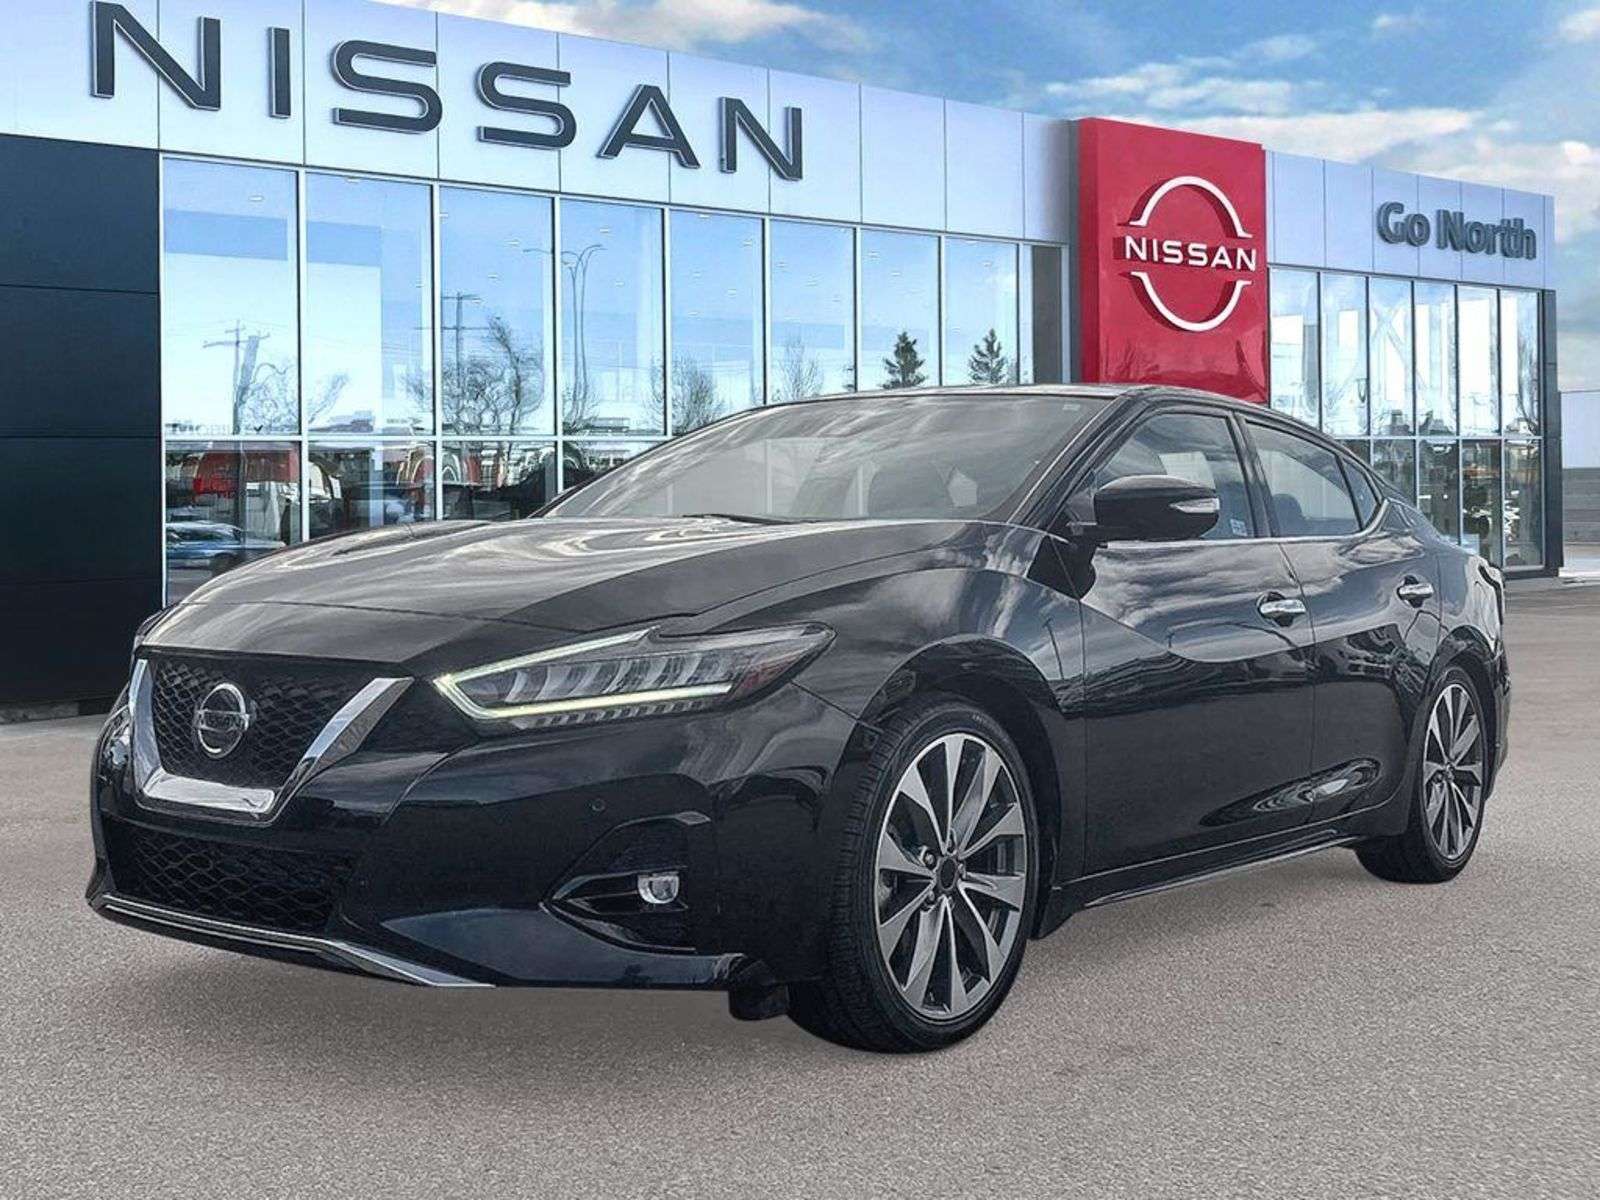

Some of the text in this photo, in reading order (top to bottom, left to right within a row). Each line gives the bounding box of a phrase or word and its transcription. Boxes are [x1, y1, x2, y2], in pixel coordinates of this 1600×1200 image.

[90, 1, 803, 181] NISSAN
[1124, 235, 1257, 272] NISSAN
[1377, 201, 1536, 260] Go North
